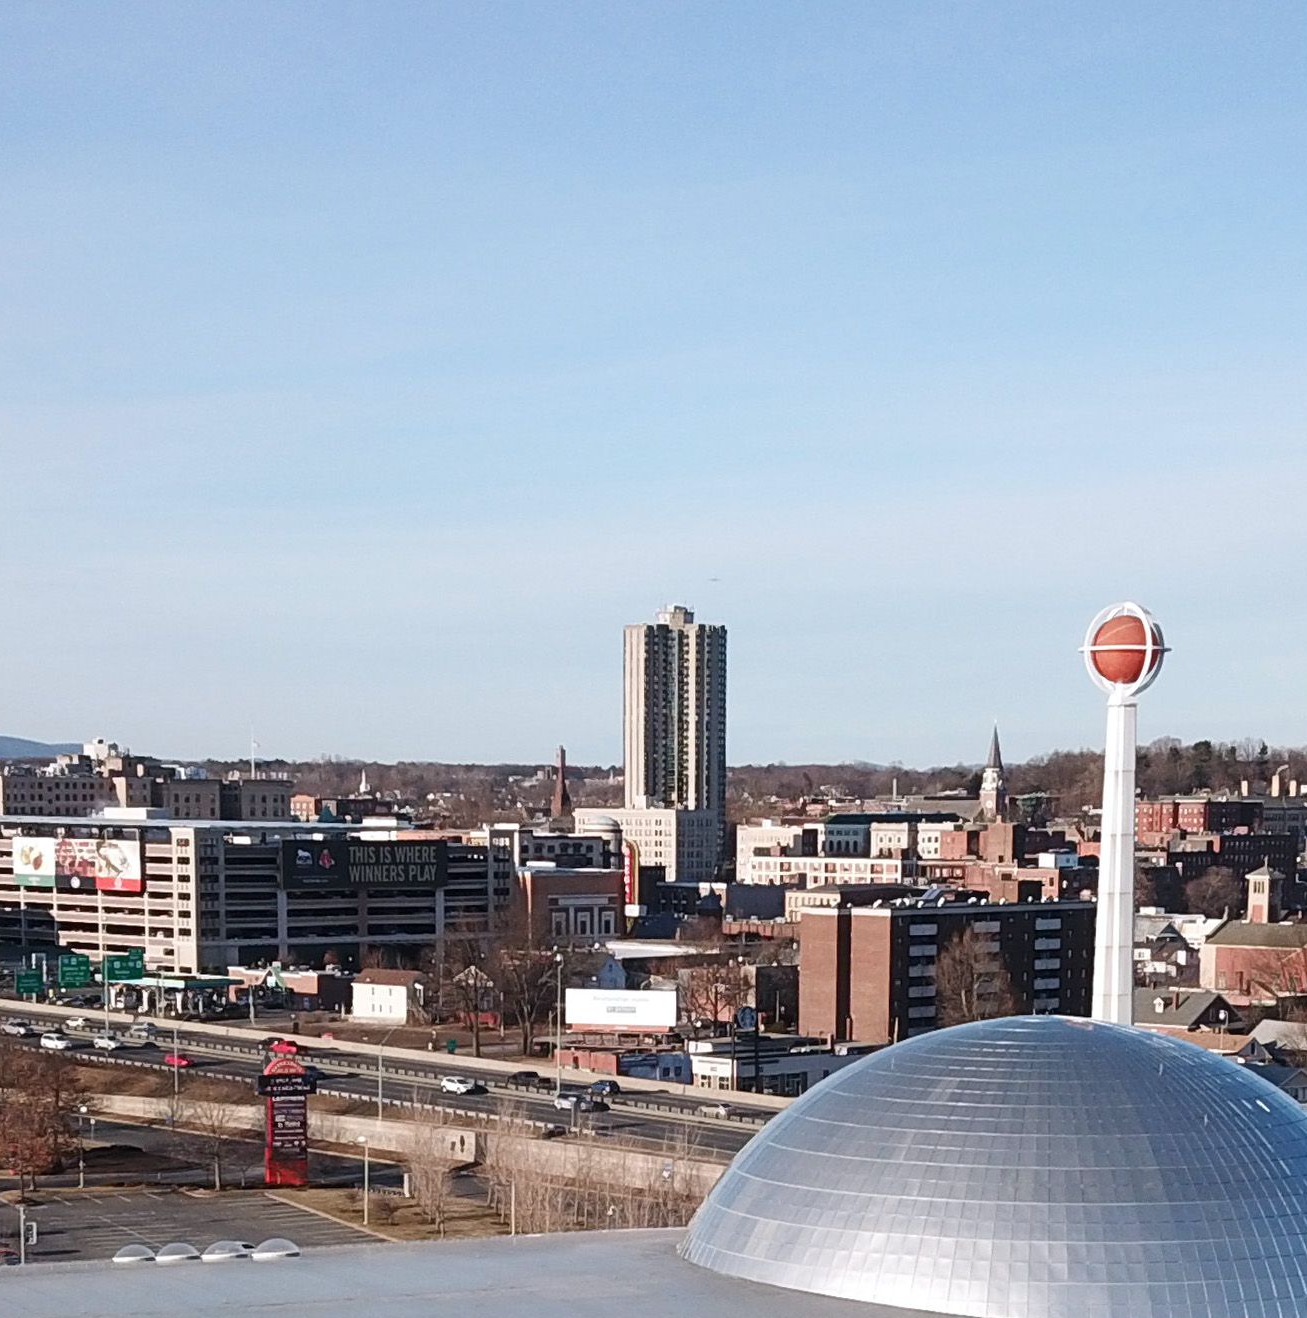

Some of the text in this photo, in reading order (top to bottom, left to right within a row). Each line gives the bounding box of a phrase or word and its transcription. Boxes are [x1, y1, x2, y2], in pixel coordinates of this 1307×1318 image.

[349, 846, 437, 864] THIS IS WHERE
[349, 865, 405, 882] WINNERS
[409, 865, 437, 881] PLAY
